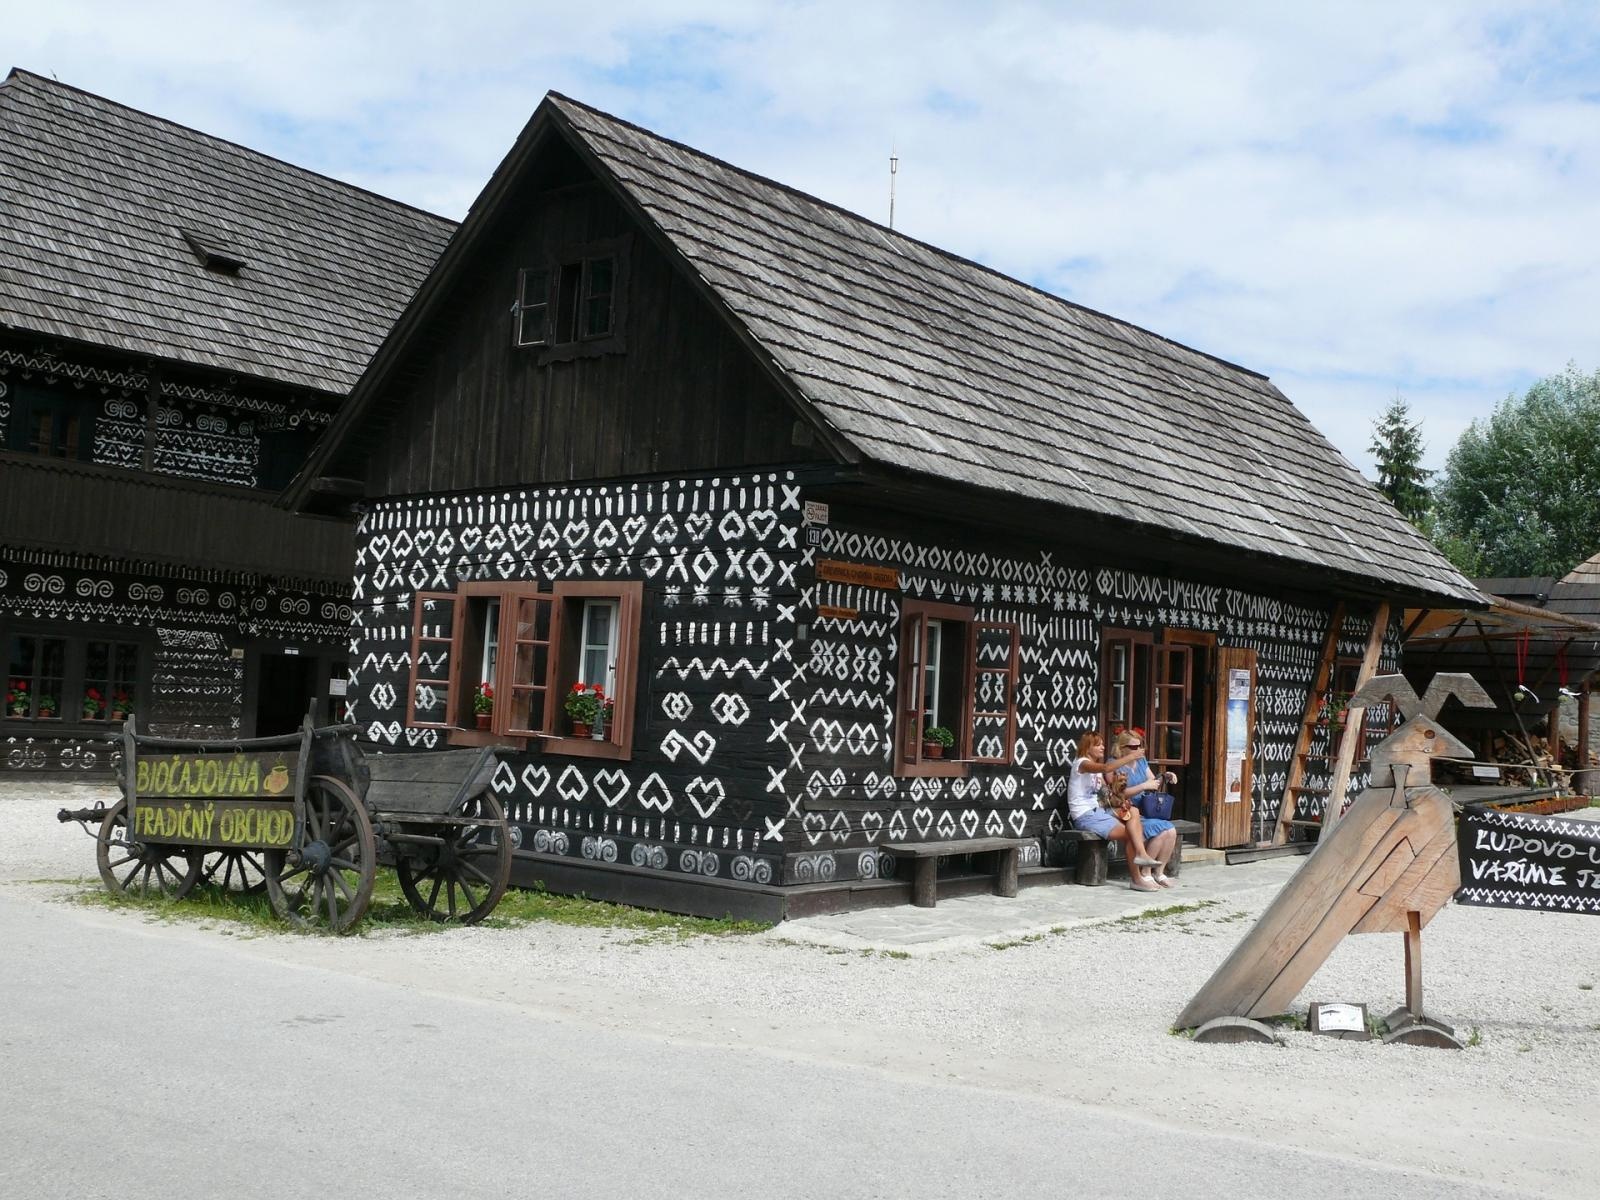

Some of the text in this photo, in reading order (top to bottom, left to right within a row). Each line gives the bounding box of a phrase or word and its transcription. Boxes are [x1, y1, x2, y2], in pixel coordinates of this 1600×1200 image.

[136, 754, 259, 794] BIOČAJOVŇA
[134, 802, 295, 845] TRADIČNÝ OBCHOD
[1470, 858, 1567, 887] VARÍME
